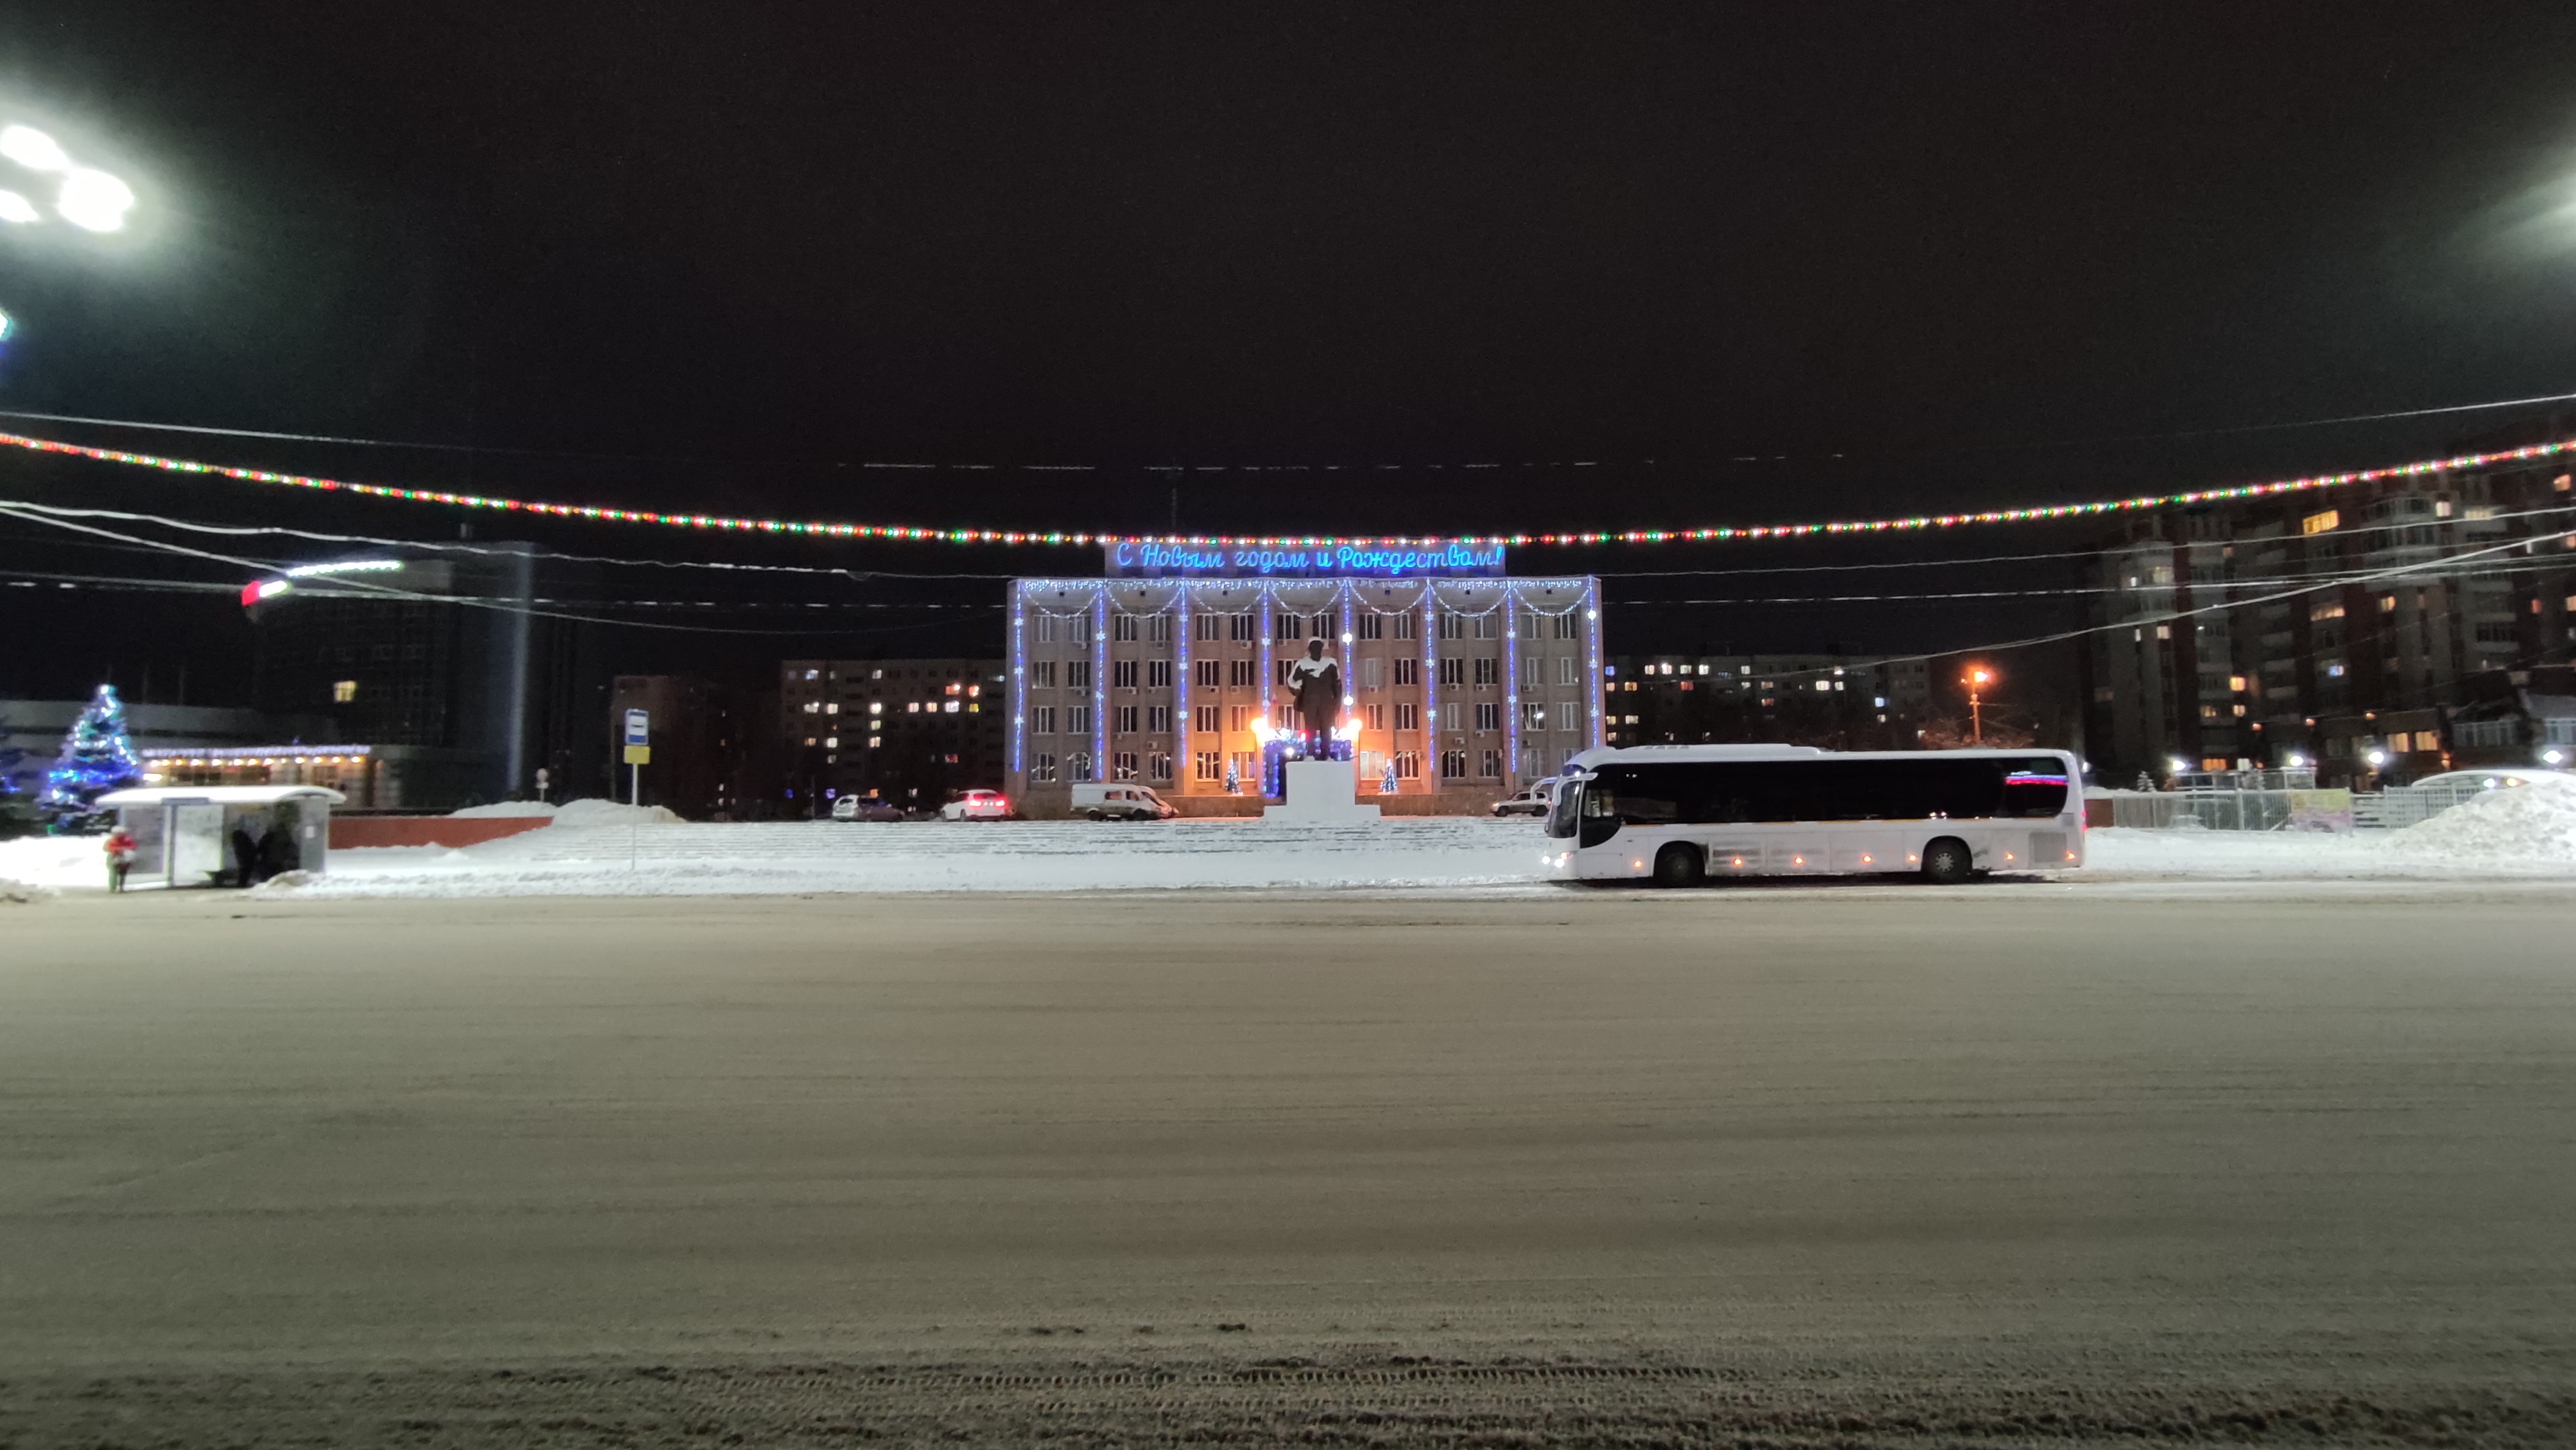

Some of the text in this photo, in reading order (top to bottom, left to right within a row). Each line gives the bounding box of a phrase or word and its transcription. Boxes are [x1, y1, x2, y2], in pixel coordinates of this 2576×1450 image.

[1117, 543, 1503, 575] С Новым годом и Рождеством!
